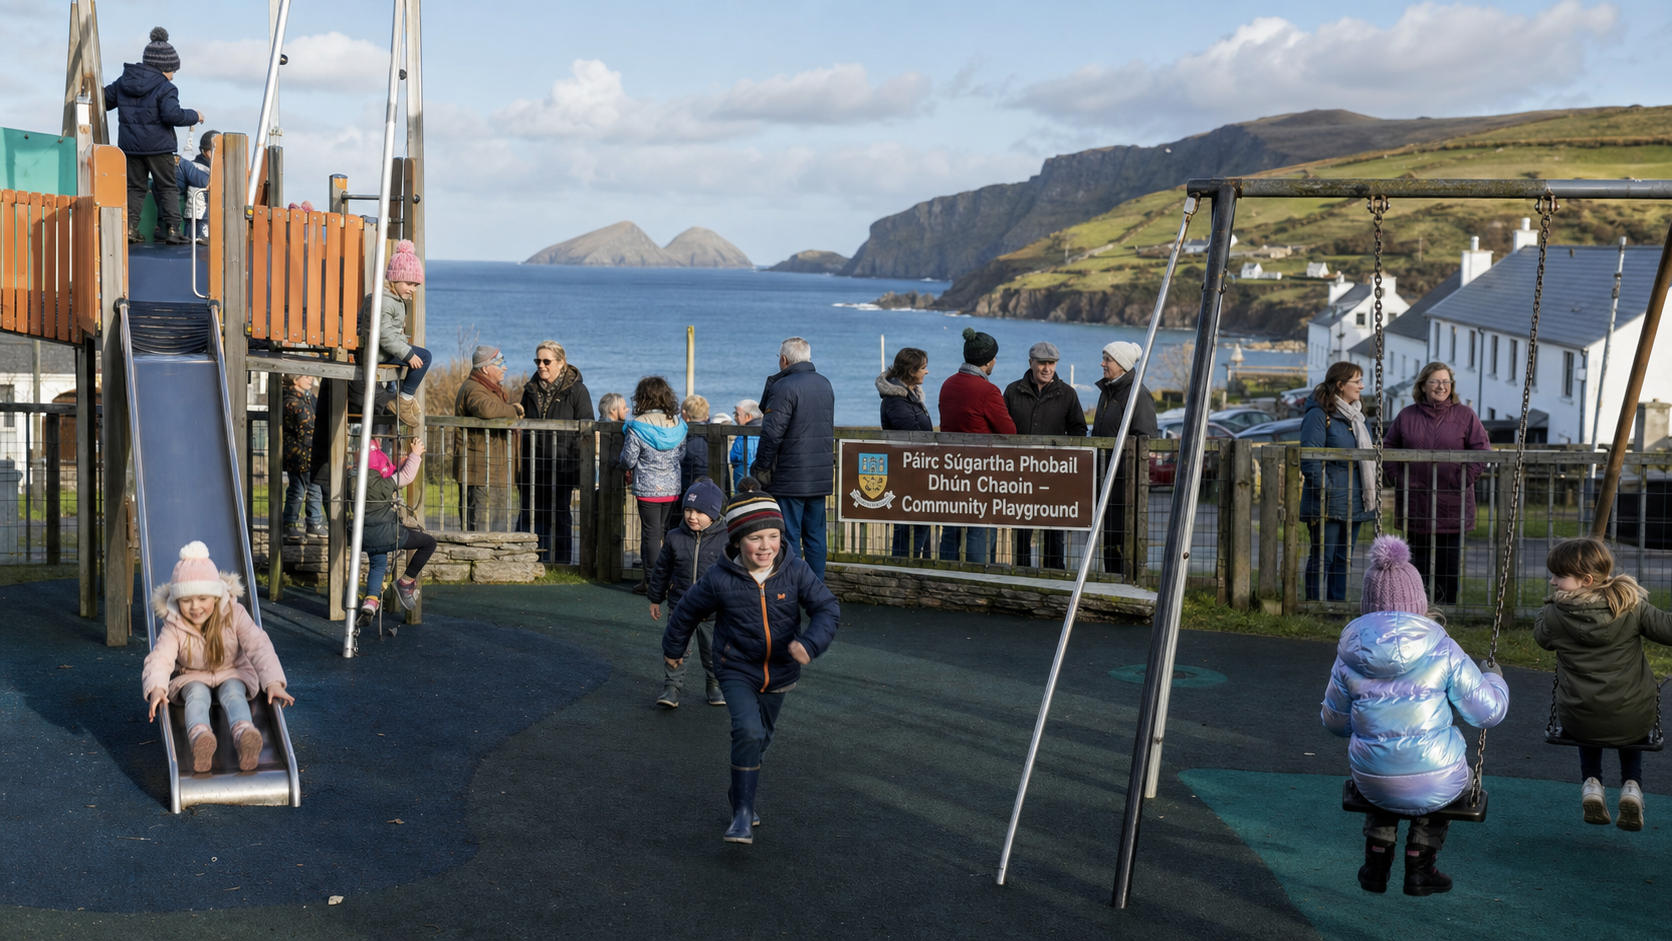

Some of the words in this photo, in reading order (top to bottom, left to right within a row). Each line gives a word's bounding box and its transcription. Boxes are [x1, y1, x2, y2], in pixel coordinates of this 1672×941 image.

[903, 451, 940, 469] Páirc
[943, 453, 1015, 474] Súgartha
[1019, 455, 1078, 474] Phobail
[928, 473, 971, 492] Dhún
[977, 476, 1033, 494] Chaoin
[902, 495, 987, 518] Community
[992, 498, 1079, 520] Playground
